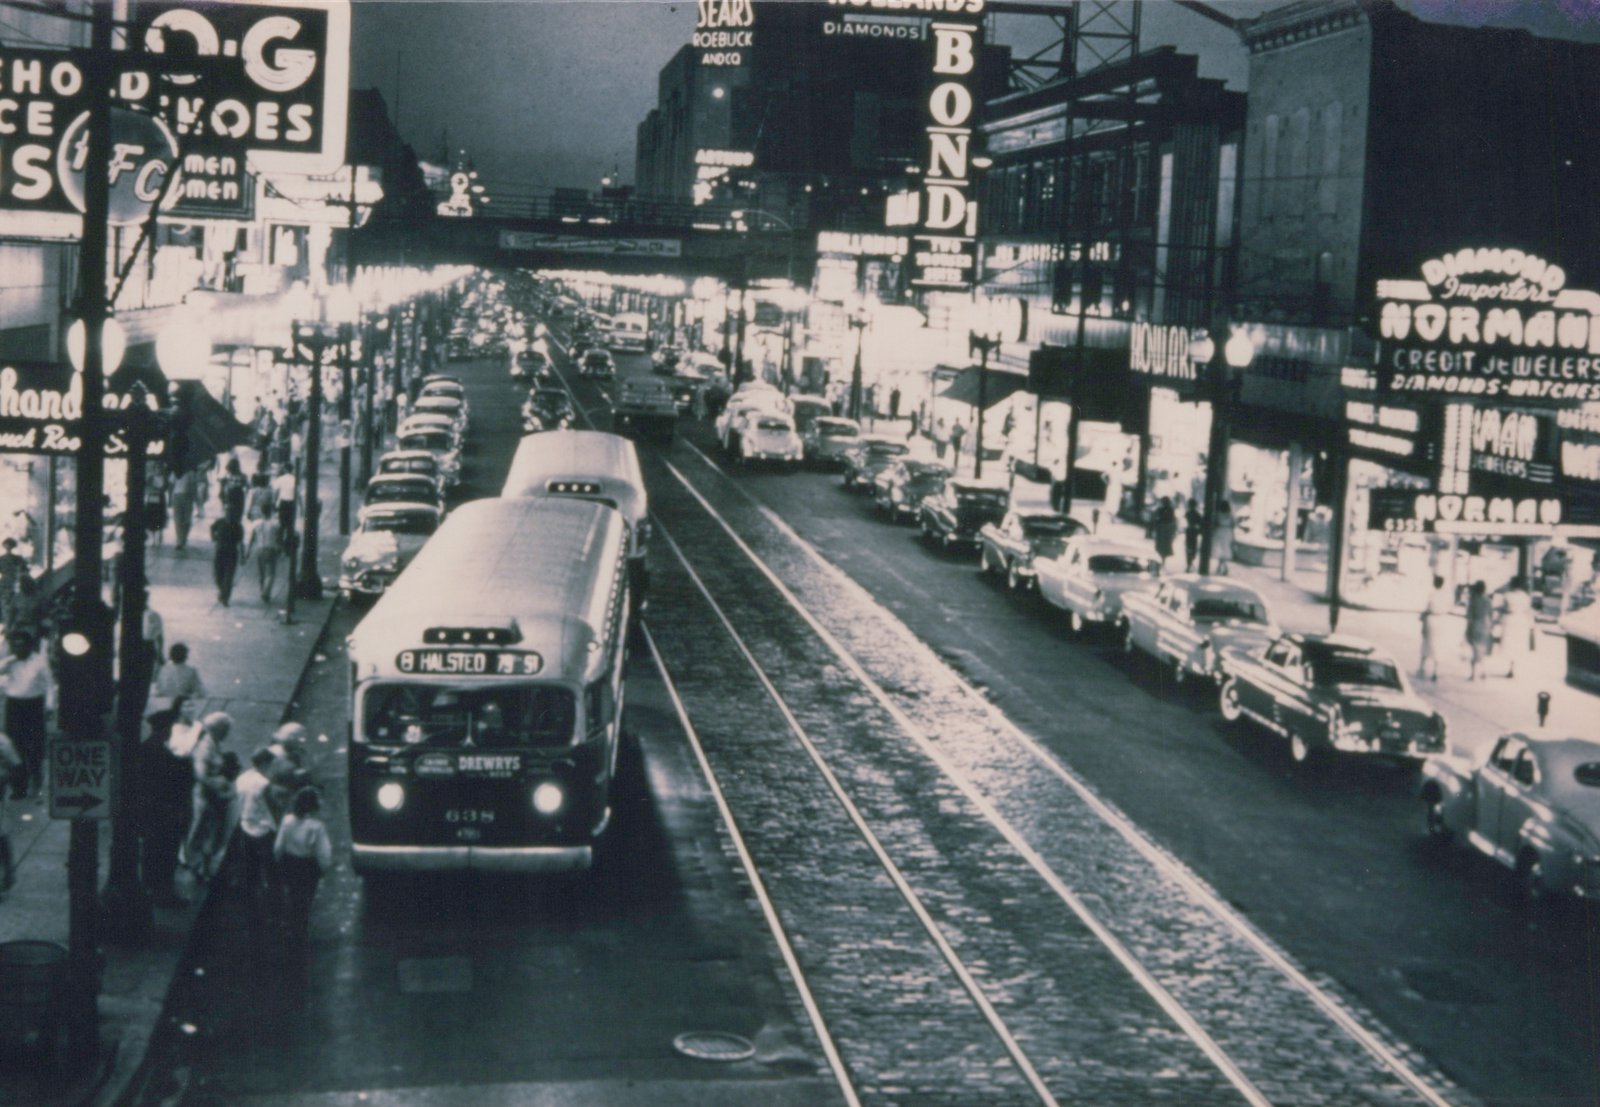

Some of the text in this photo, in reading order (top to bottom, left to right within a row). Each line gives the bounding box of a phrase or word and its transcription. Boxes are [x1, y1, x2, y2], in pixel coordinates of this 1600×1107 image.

[697, 0, 753, 28] SEARS
[692, 31, 753, 48] ROEBUCK
[823, 22, 920, 39] DIAMONDS
[160, 98, 313, 142] HOES
[928, 29, 975, 229] BOND
[1421, 248, 1566, 291] DIAMOND
[1379, 301, 1589, 349] NORMAN
[1130, 322, 1197, 380] HOWAR
[1393, 349, 1476, 373] CREDIT
[1414, 494, 1562, 525] NORMAN
[420, 653, 486, 672] HALSTED
[57, 746, 107, 767] ONE
[458, 756, 521, 771] DREWRYS
[57, 767, 107, 788] WAY
